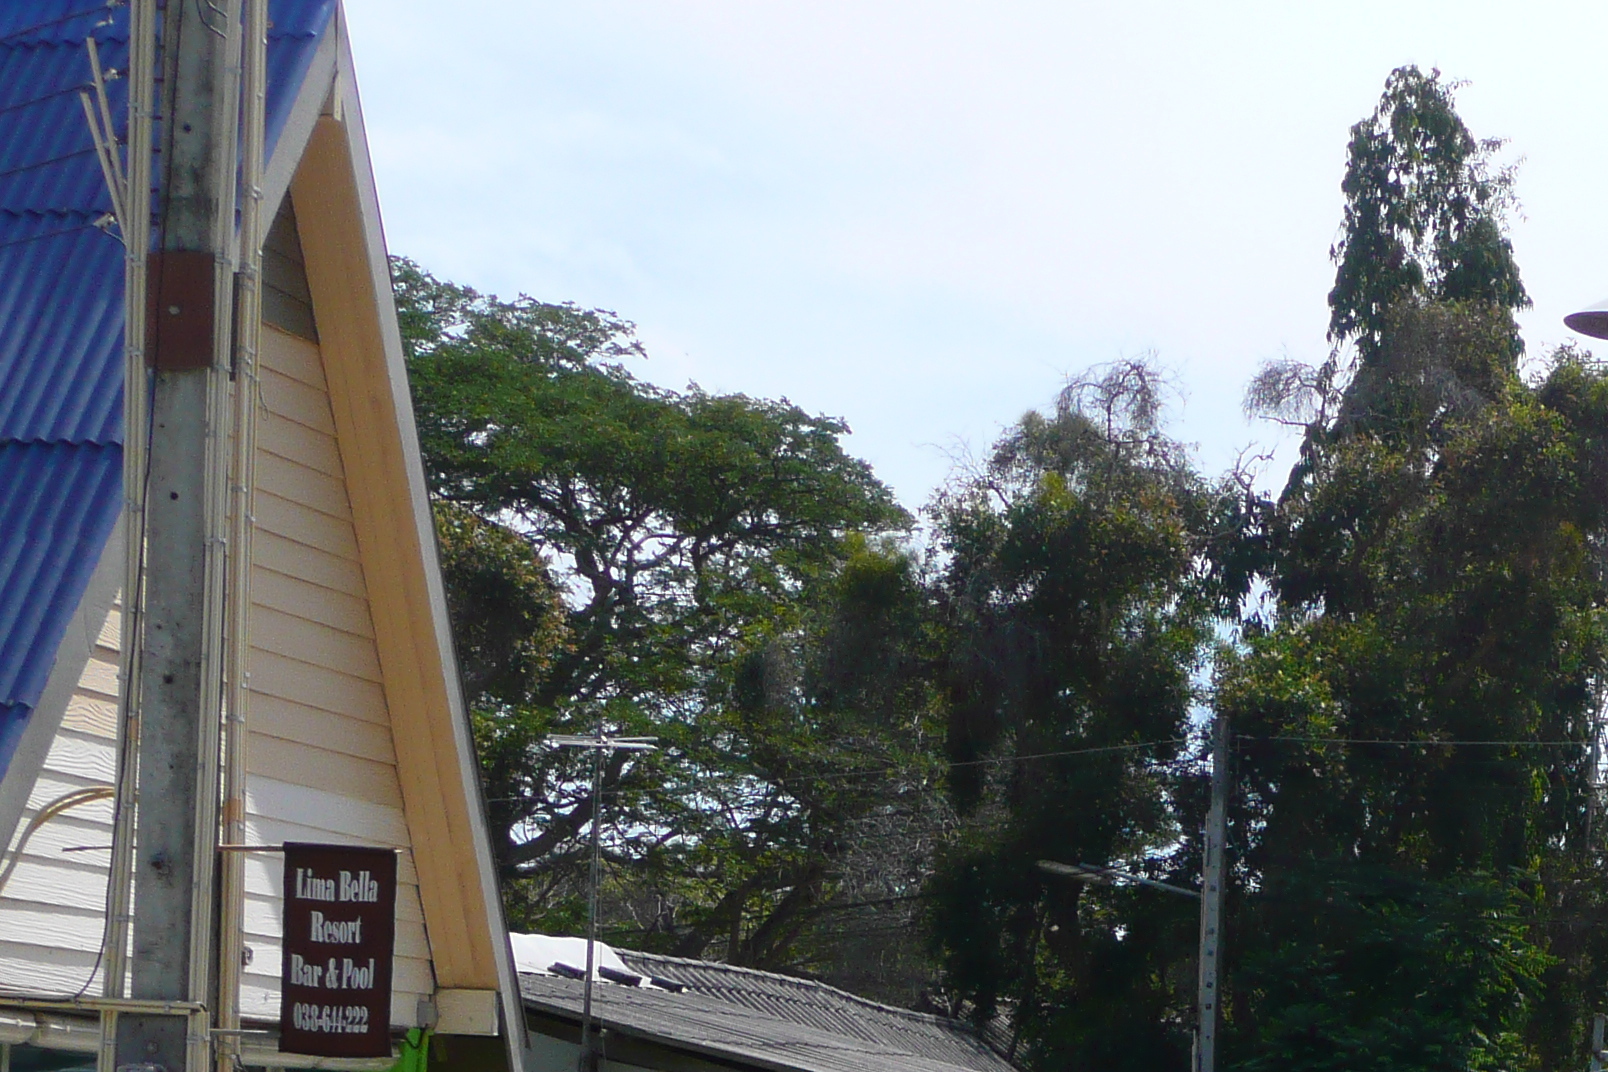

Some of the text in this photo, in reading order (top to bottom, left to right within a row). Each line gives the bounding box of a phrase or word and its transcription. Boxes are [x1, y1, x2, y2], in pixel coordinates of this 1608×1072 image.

[296, 868, 379, 903] Lima Bella
[310, 910, 362, 944] Resort
[290, 953, 375, 990] Bar & Pool
[292, 1002, 369, 1034] 038-644-222
